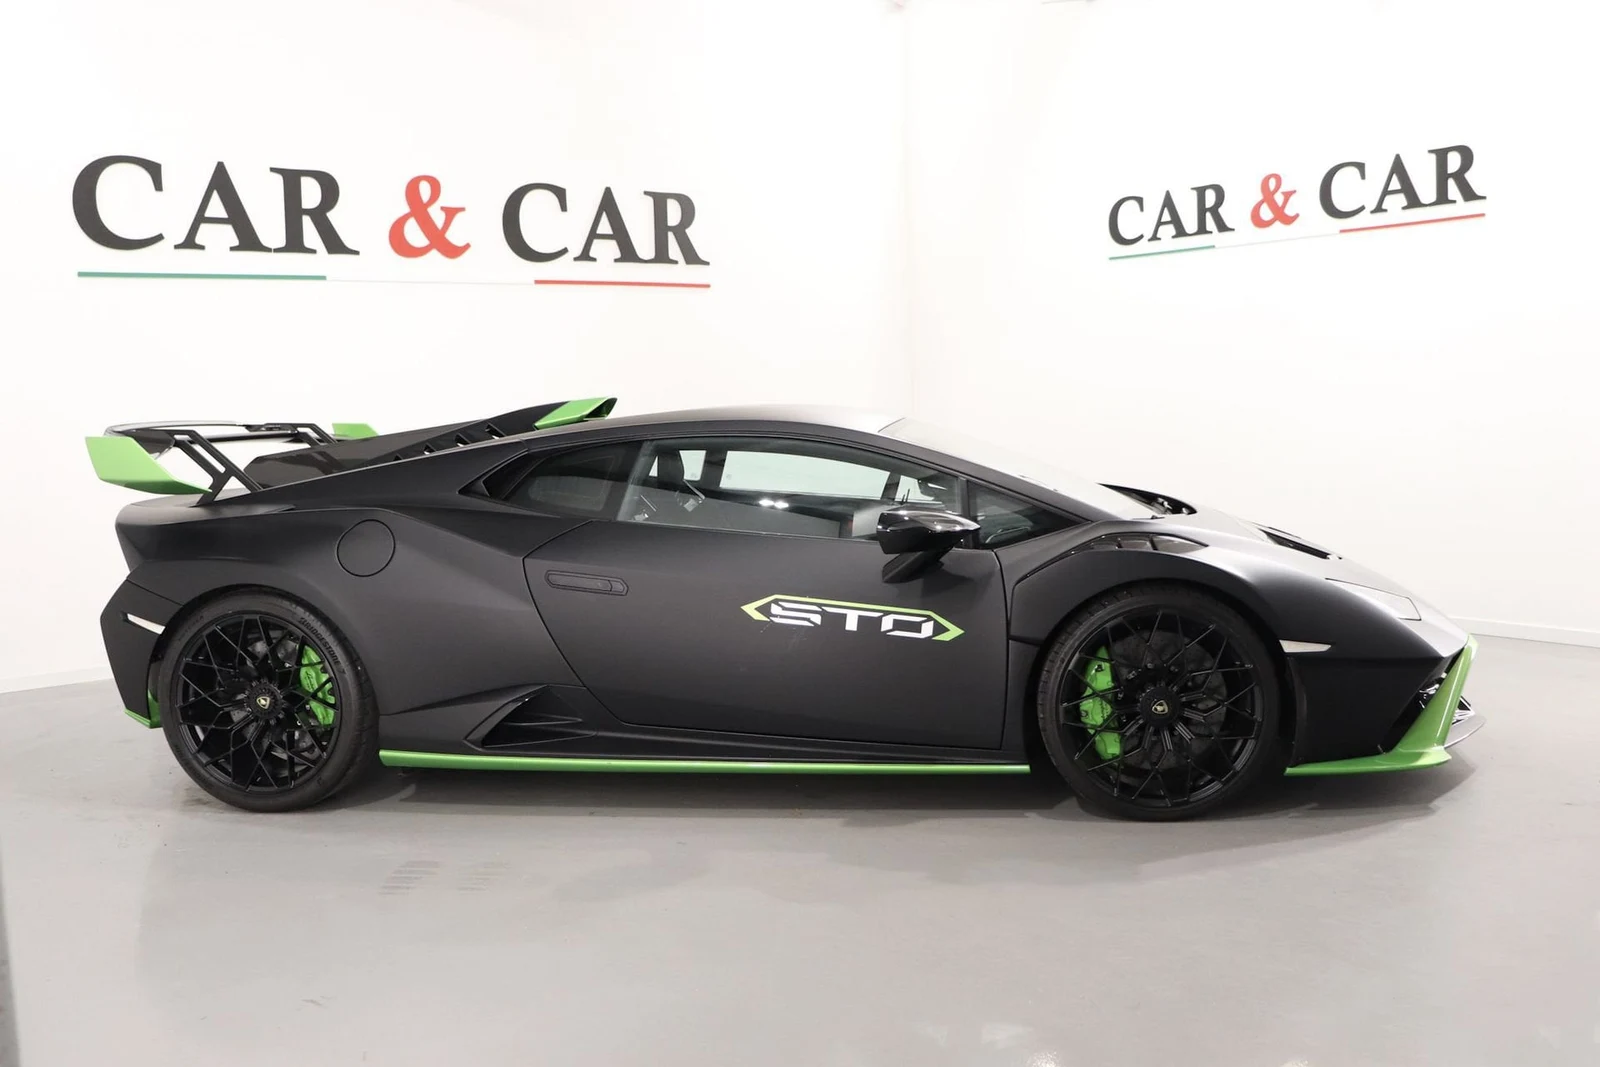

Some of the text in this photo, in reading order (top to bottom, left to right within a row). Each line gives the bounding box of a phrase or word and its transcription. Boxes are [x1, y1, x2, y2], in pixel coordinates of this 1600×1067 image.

[72, 155, 710, 266] CAR & CAR
[1108, 144, 1487, 246] CAR & CAR
[298, 616, 342, 666] BRIDGESTONE
[769, 601, 935, 640] STO
